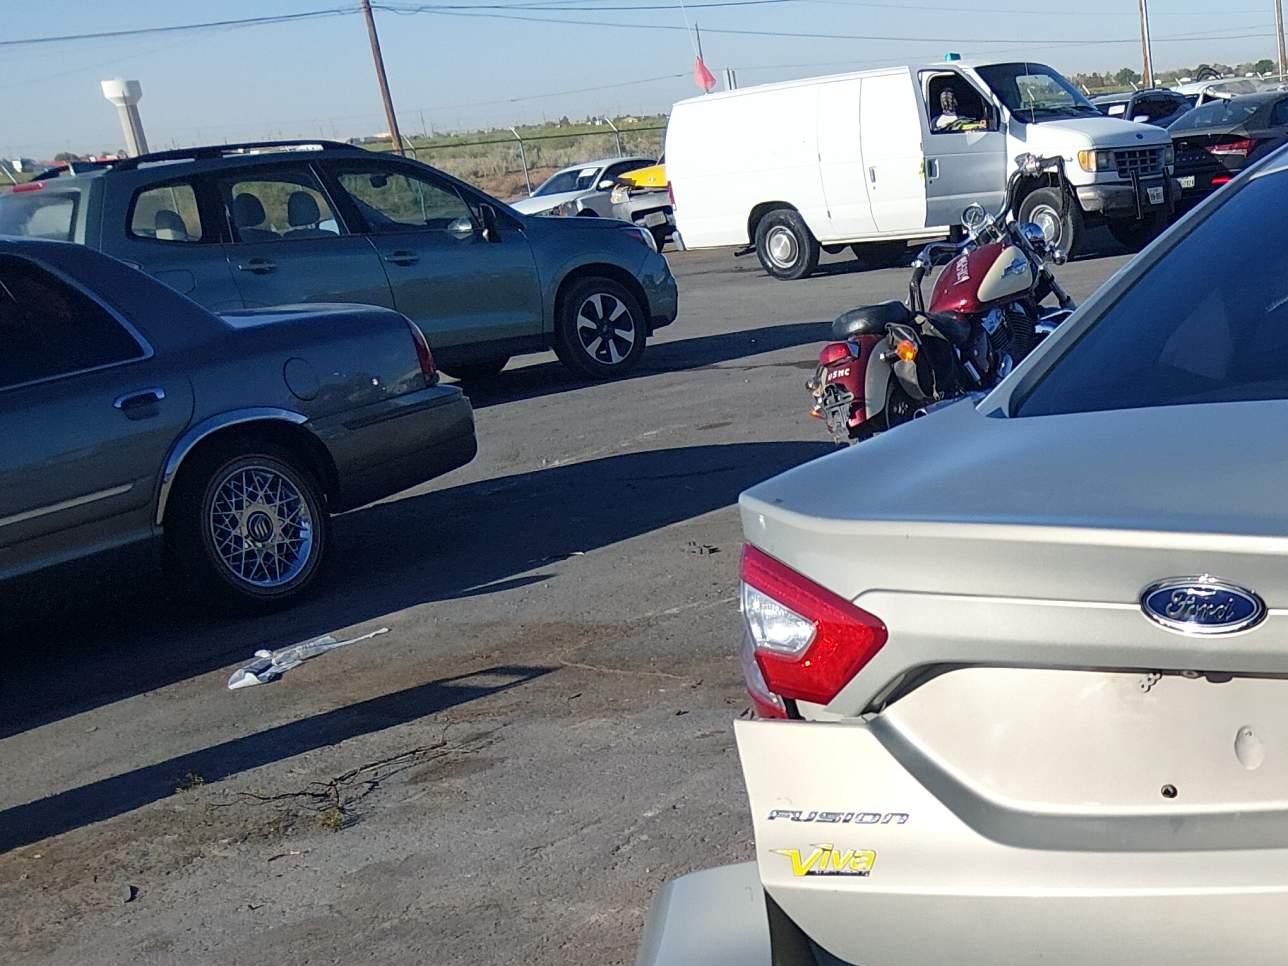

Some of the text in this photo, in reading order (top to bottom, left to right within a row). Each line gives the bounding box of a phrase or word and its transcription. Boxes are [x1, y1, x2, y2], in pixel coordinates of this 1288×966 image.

[1165, 588, 1235, 621] Ford
[767, 809, 910, 825] FUSION
[768, 842, 877, 877] Viva
